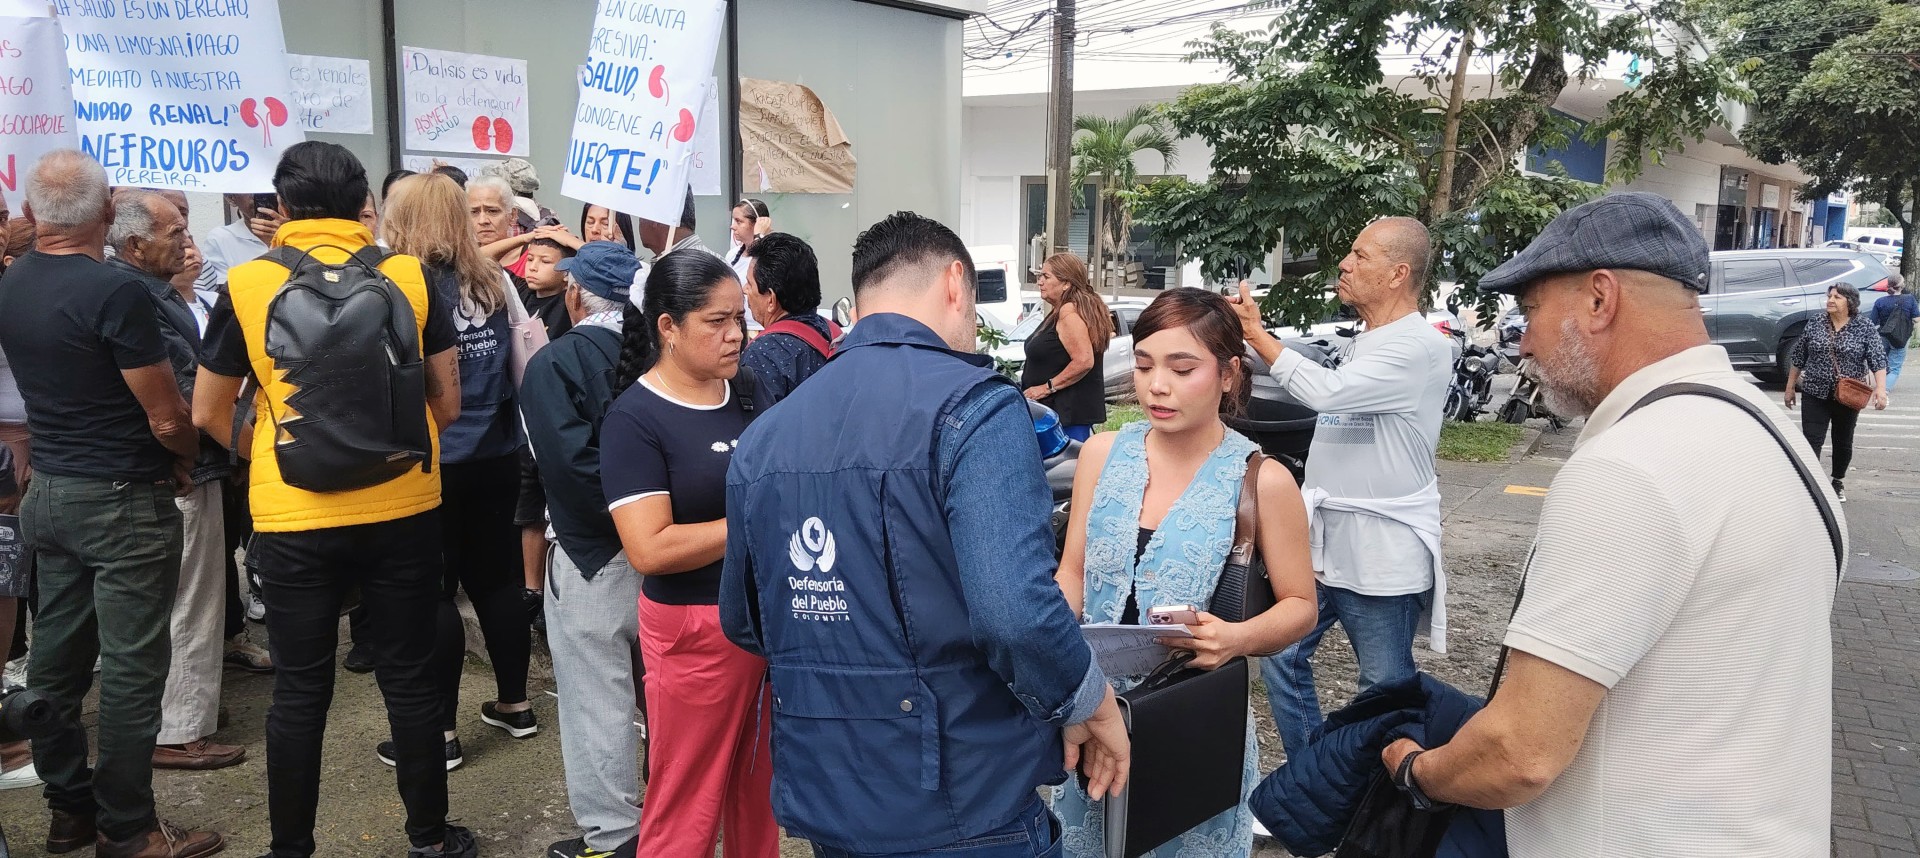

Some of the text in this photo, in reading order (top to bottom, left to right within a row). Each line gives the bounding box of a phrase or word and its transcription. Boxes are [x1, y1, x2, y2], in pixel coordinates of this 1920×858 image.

[74, 0, 116, 19] SALUD
[124, 0, 145, 20] ES
[147, 0, 170, 20] UN
[175, 0, 249, 20] DERECHO,
[605, 0, 627, 19] EN
[629, 1, 686, 31] CUENTA
[76, 33, 110, 53] UNA
[114, 35, 188, 58] LIMOSNA,
[69, 67, 242, 91] MEDIATO A NUESTRA
[317, 65, 367, 86] renales
[472, 67, 488, 79] es
[332, 88, 353, 108] de
[415, 91, 430, 102] no
[435, 85, 447, 104] la
[73, 99, 132, 122] NIDAD
[414, 103, 449, 136] ASMET
[427, 115, 460, 141] SALUD
[577, 102, 664, 142] CONDENE A
[81, 132, 250, 174] NEFROUROS
[115, 167, 207, 188] PEREIRA.
[566, 138, 669, 195] UERTE!"
[466, 339, 498, 352] Pueblo
[788, 576, 845, 592] Defensoría
[791, 594, 848, 611] del Pueblo
